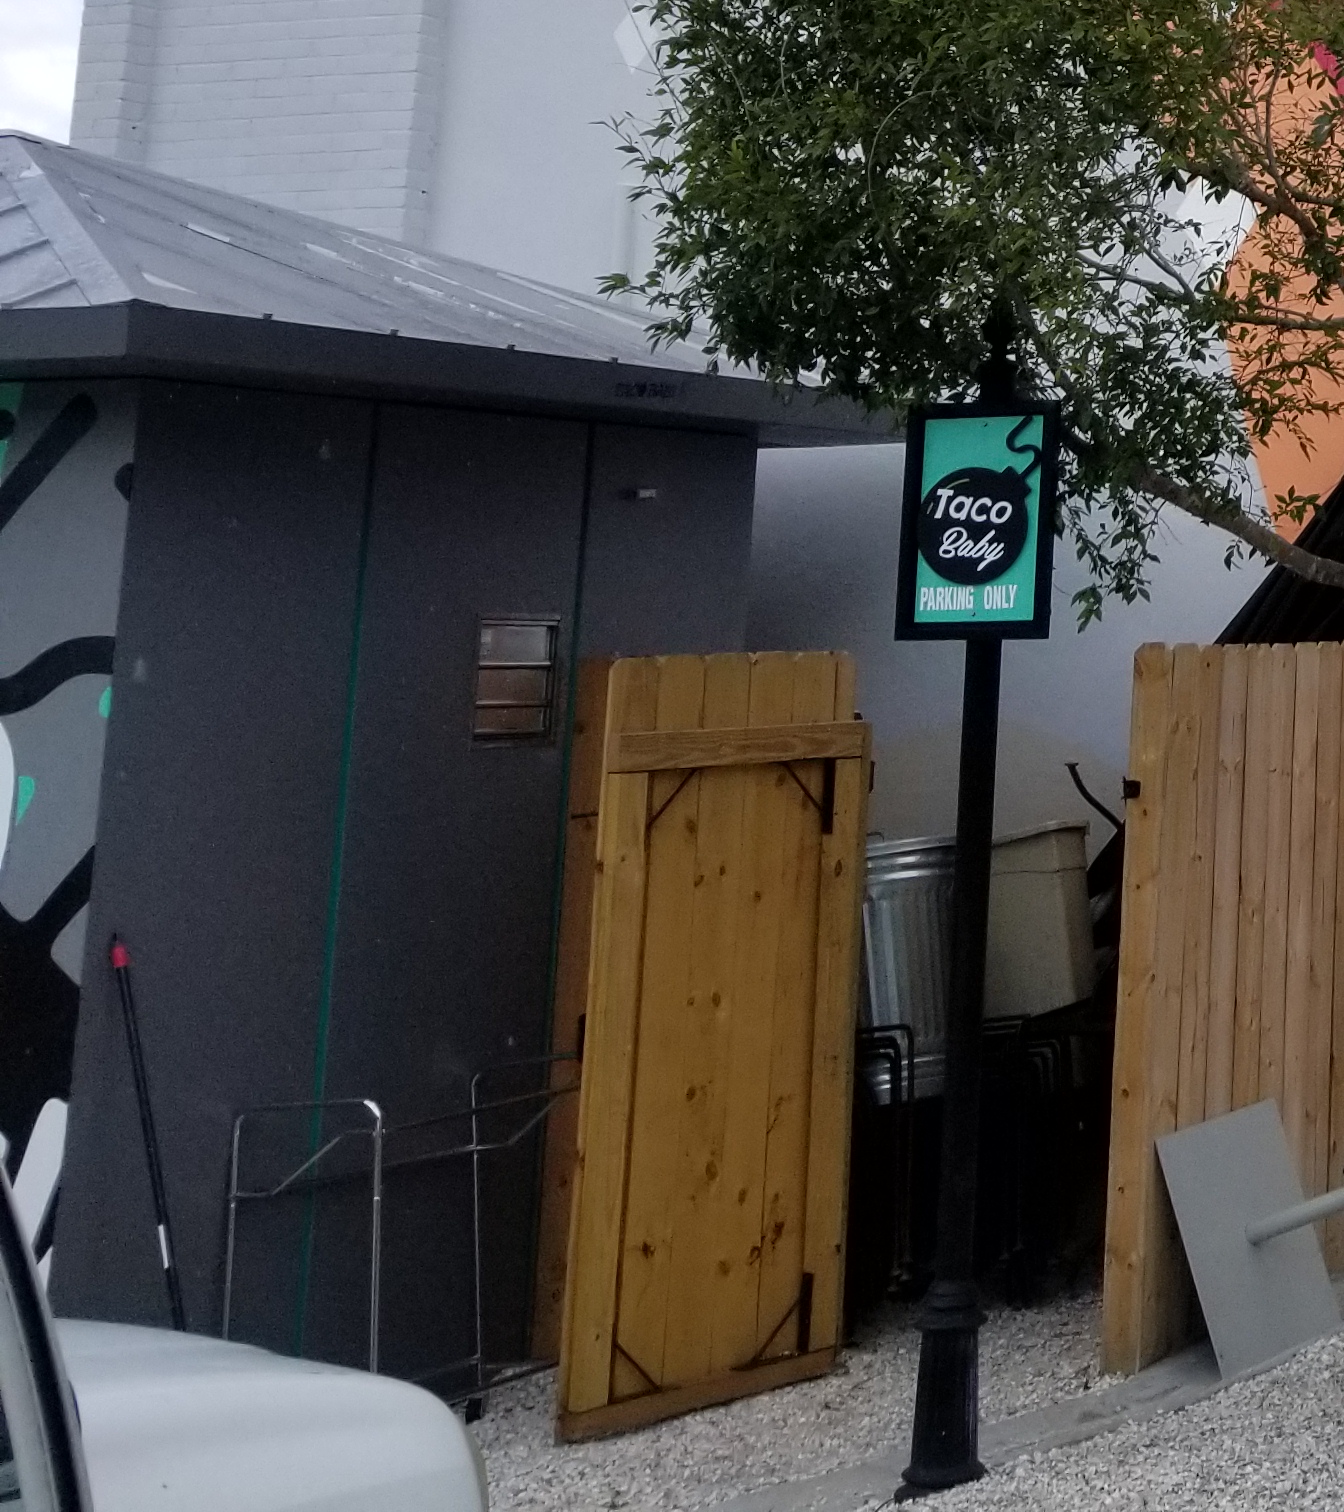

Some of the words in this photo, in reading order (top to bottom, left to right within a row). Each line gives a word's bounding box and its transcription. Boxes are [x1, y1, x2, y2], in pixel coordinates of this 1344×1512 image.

[934, 488, 1012, 524] Taco
[938, 527, 1004, 571] Baby
[919, 586, 974, 611] PARKING
[983, 585, 1018, 610] ONLY
